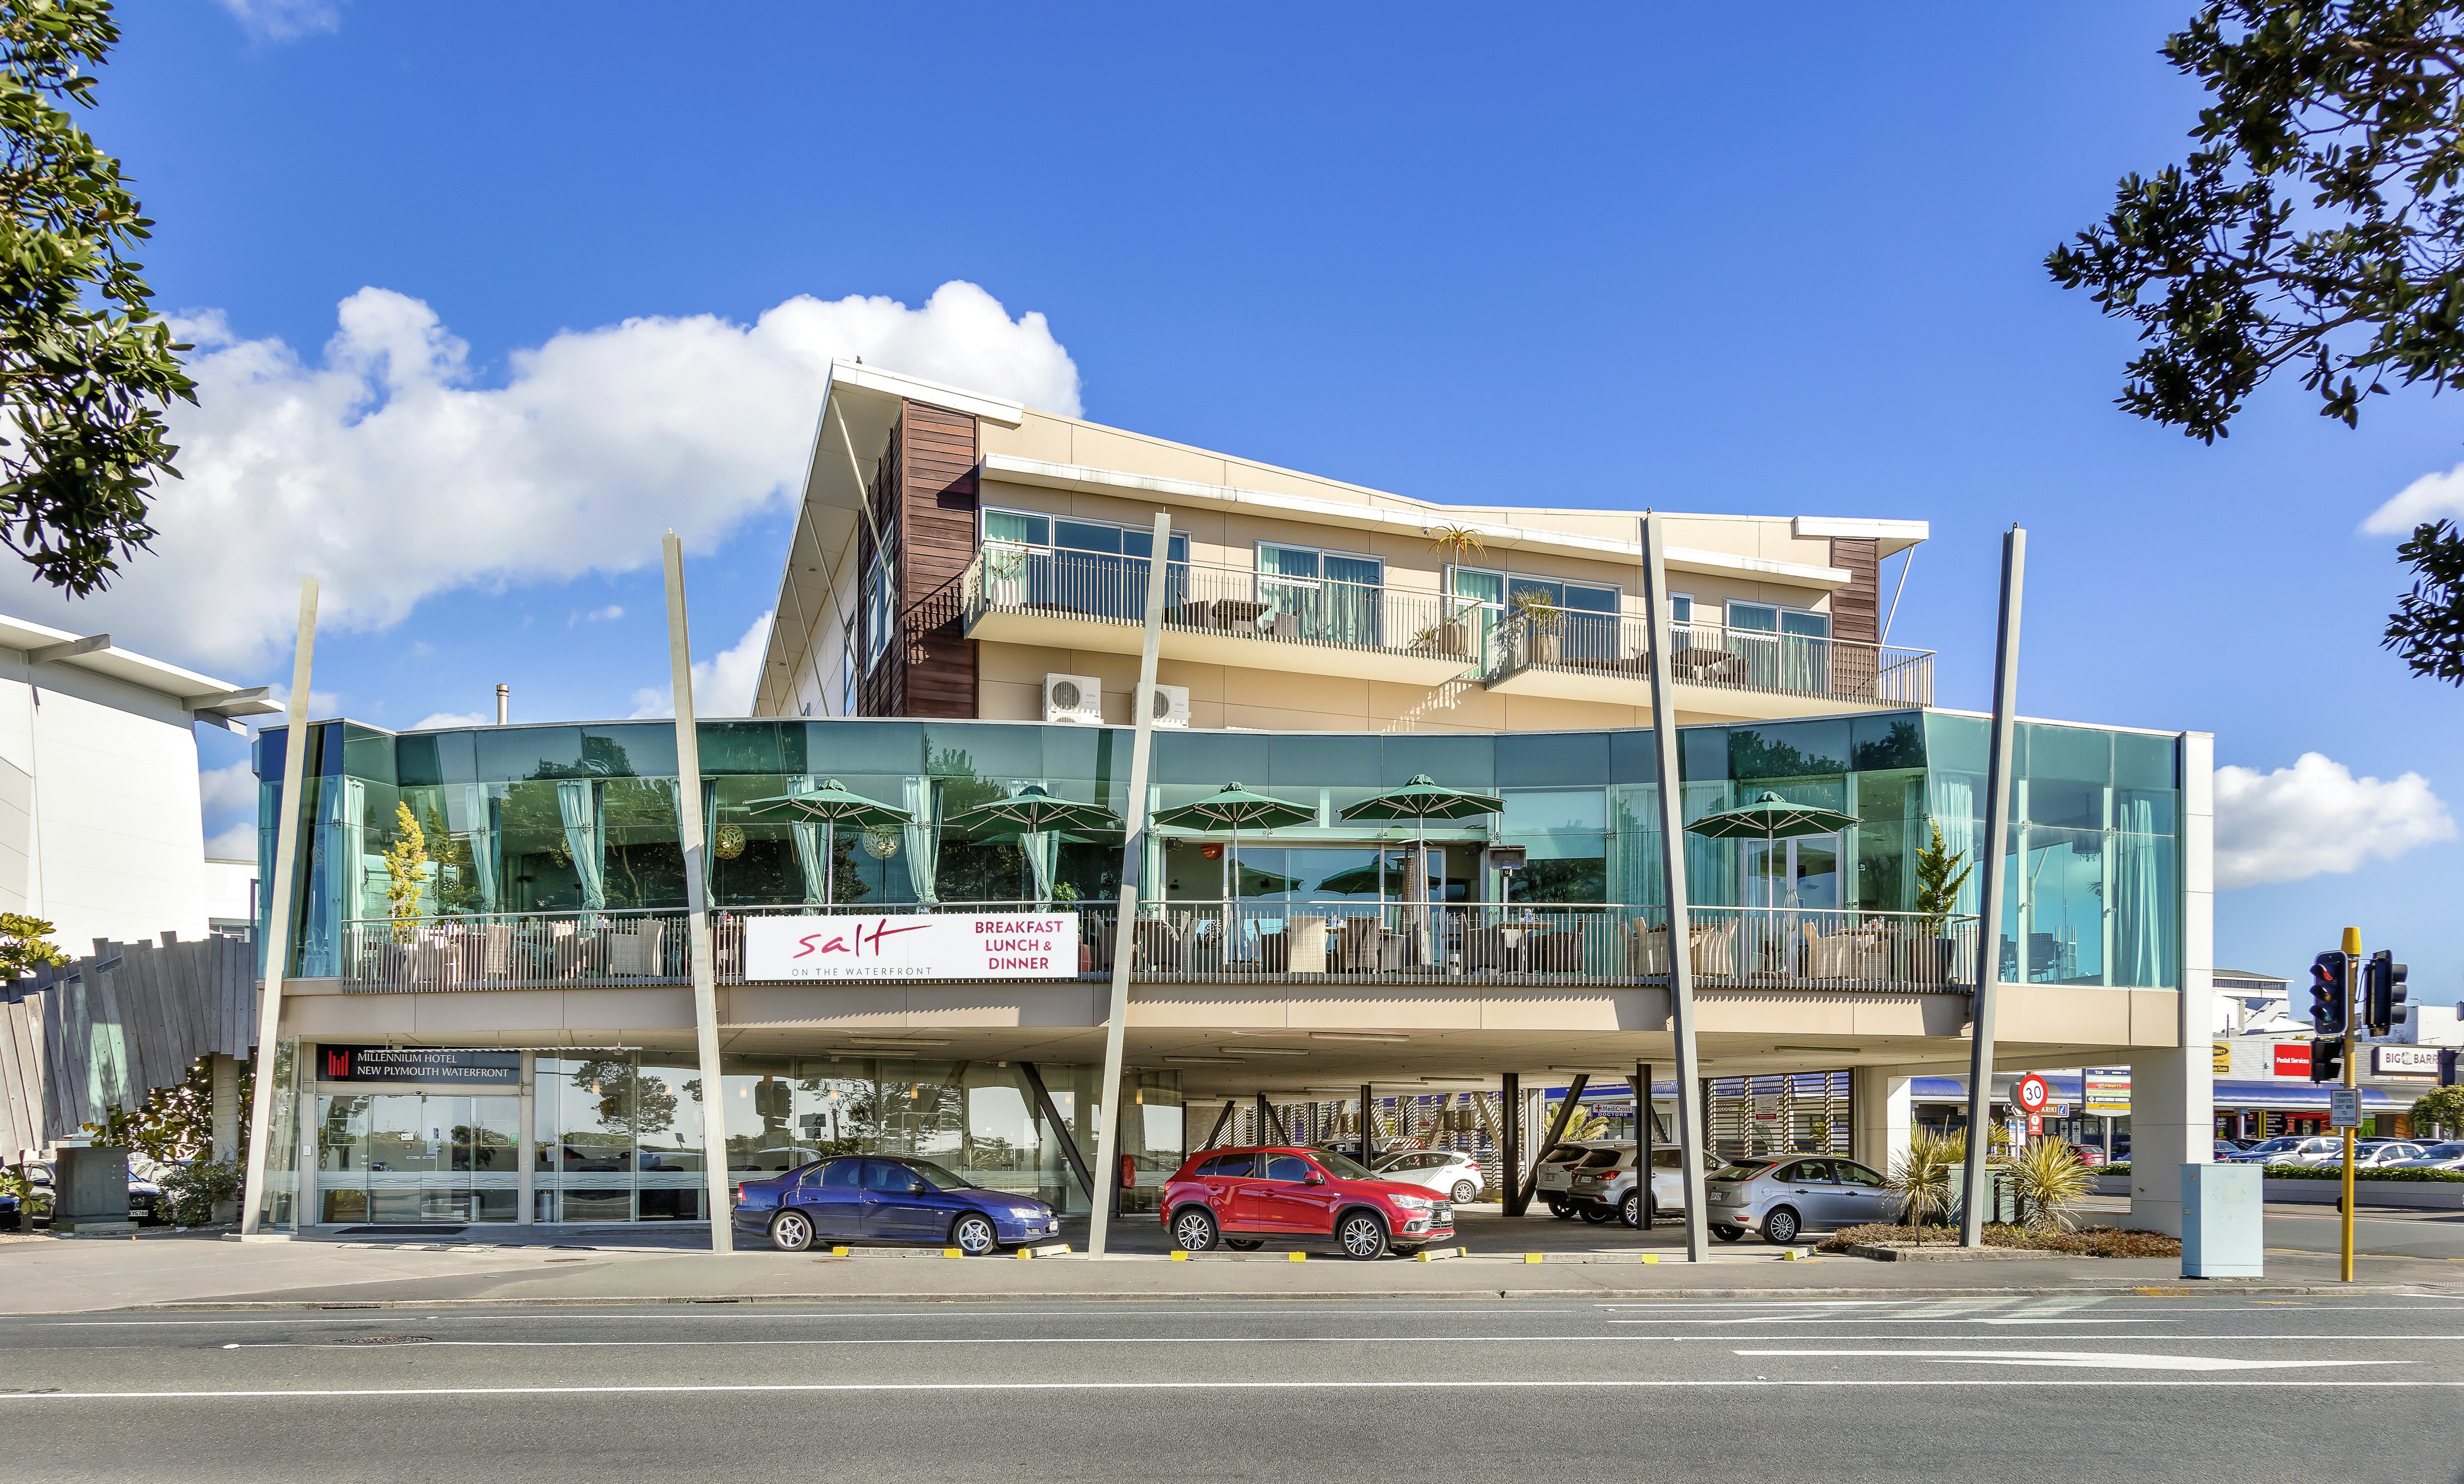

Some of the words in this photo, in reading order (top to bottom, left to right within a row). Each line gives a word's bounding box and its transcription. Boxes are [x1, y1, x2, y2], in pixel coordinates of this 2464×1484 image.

[975, 921, 1064, 933] BREAKFAST
[793, 919, 932, 958] salt
[986, 939, 1038, 951] LUNCH
[1043, 941, 1052, 951] &
[989, 957, 1049, 970] DINNER
[791, 968, 808, 976] ON
[815, 968, 838, 976] THE
[845, 967, 932, 976] WATERFRONT
[357, 1053, 422, 1062] MILLENNIUM
[425, 1054, 457, 1063] HOTEL
[2385, 1053, 2401, 1063] BIG
[2414, 1053, 2438, 1065] BARR
[357, 1066, 381, 1075] NEW
[384, 1066, 439, 1076] PLYMOUTH
[442, 1068, 509, 1077] WATERFRONT
[2026, 1086, 2042, 1101] 30
